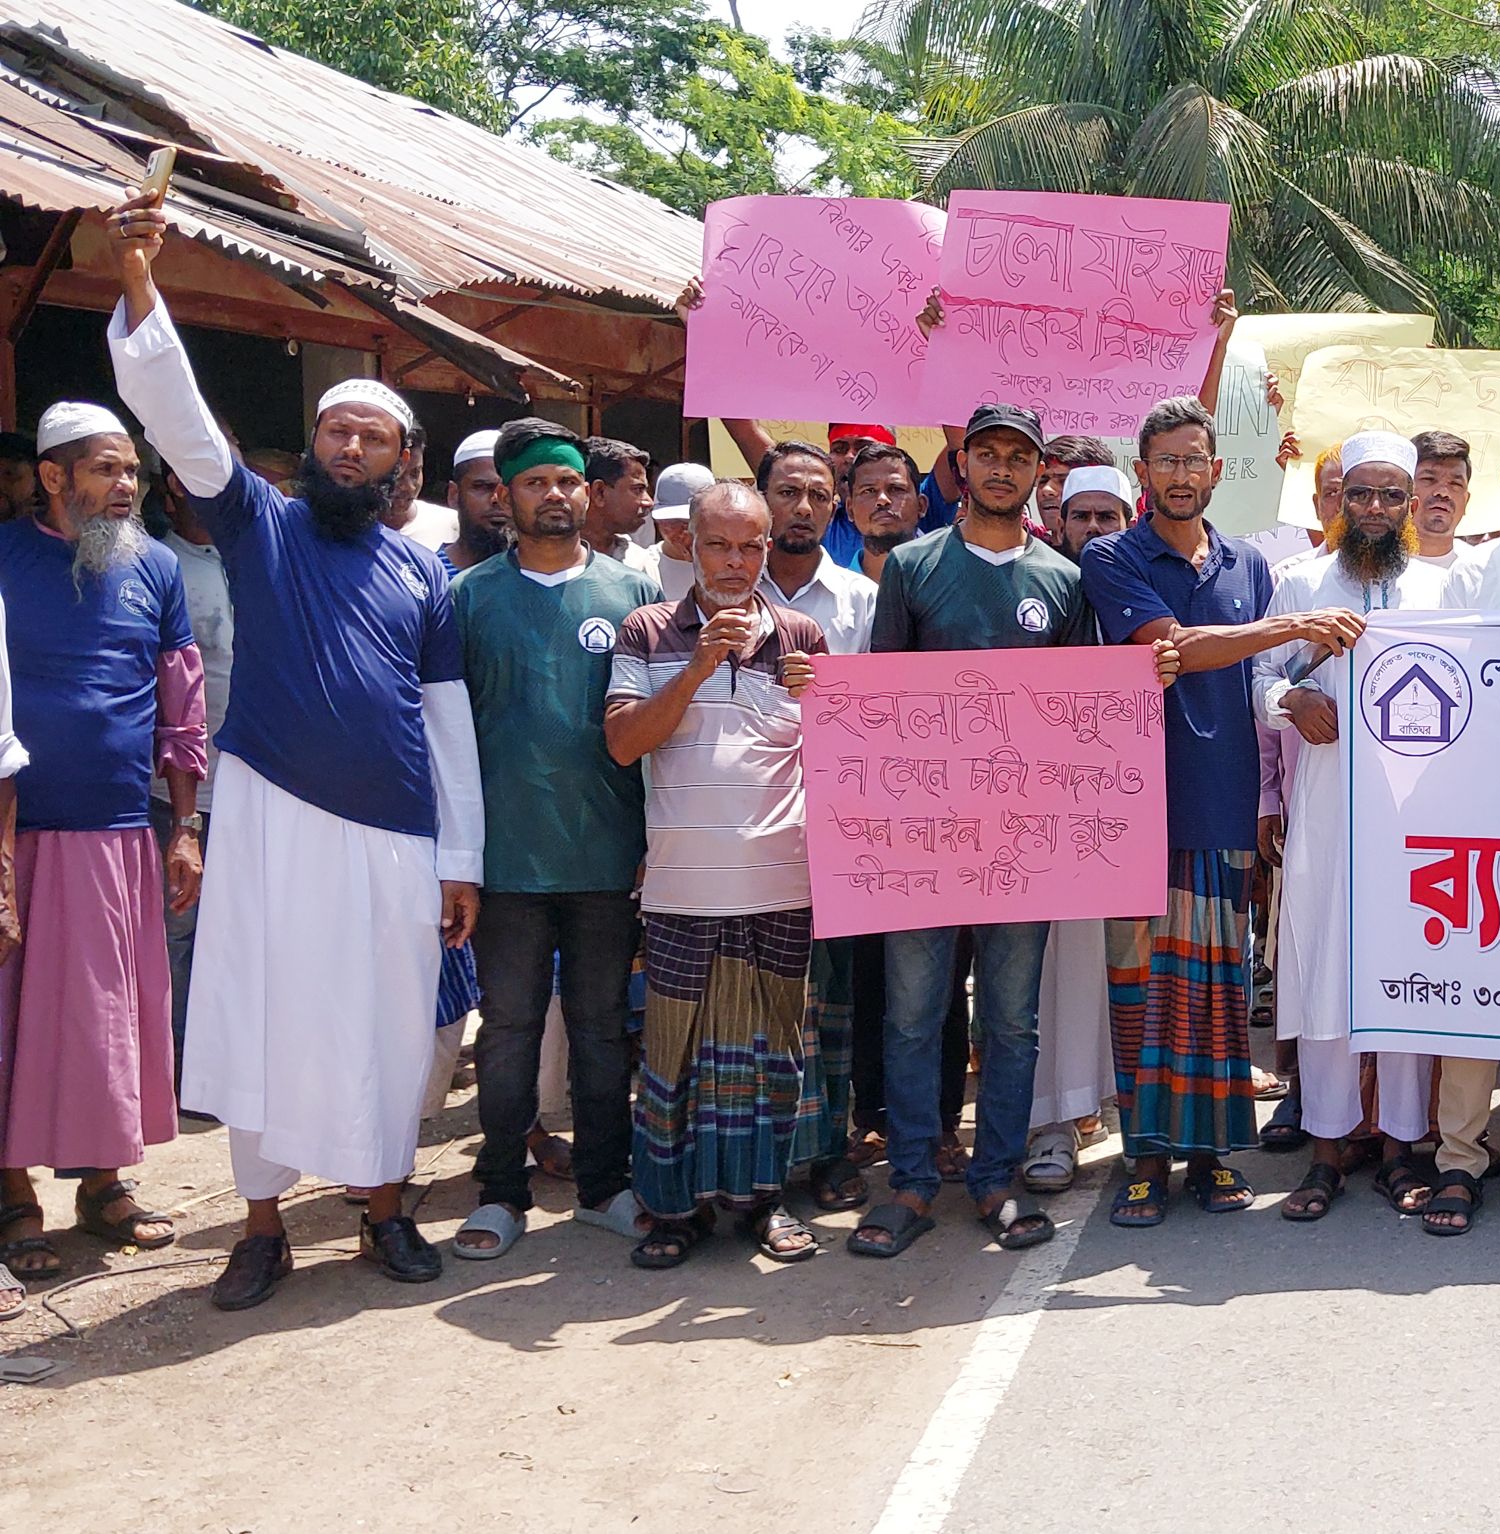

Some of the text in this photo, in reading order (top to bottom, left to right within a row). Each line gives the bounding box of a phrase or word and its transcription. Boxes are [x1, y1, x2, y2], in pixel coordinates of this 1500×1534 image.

[957, 207, 1075, 292] চলো
[1080, 215, 1167, 302] যাই
[943, 289, 1087, 365] মাদকের
[1398, 722, 1432, 735] বাতিঘর
[832, 854, 940, 897] জীবন
